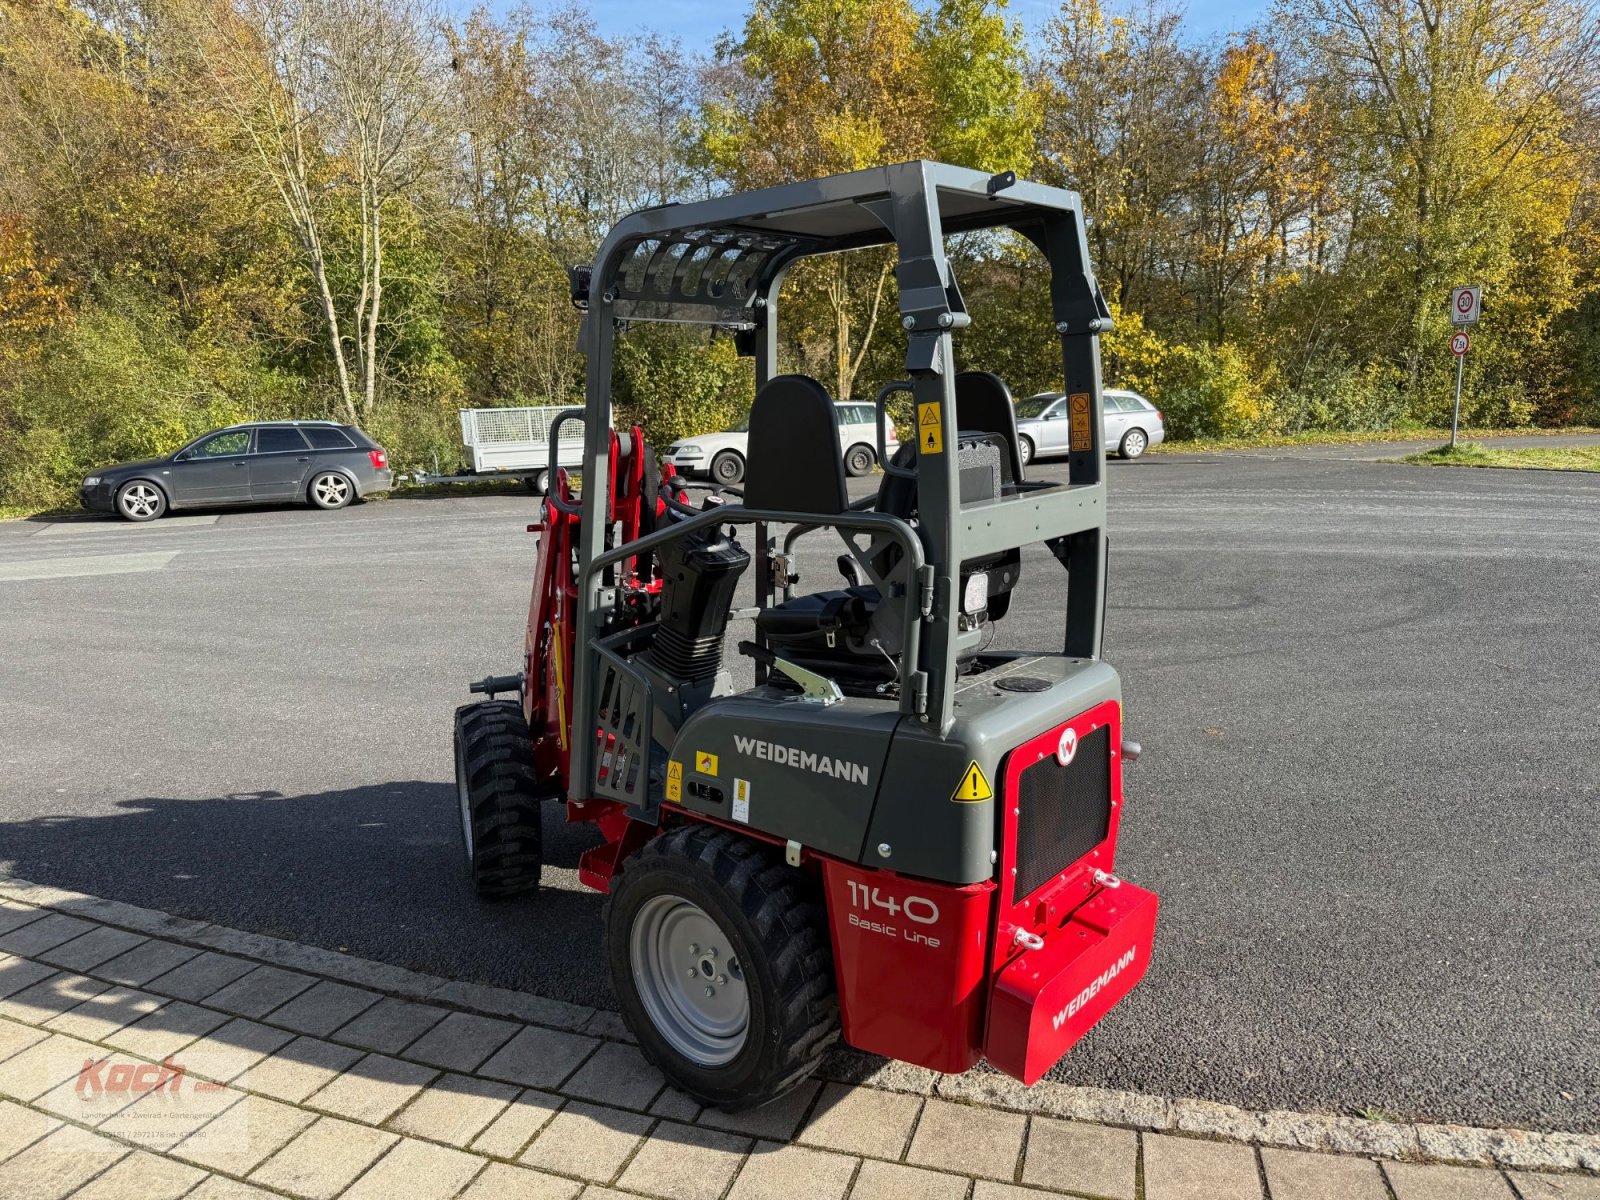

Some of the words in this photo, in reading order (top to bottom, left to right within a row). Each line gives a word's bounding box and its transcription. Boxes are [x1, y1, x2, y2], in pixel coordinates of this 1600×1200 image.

[1460, 296, 1470, 308] 30
[733, 734, 869, 786] WEIDEMANN
[847, 880, 939, 925] 1140
[848, 913, 897, 937] Basic
[903, 928, 941, 948] Line
[1052, 945, 1136, 1032] WEIDEMANN
